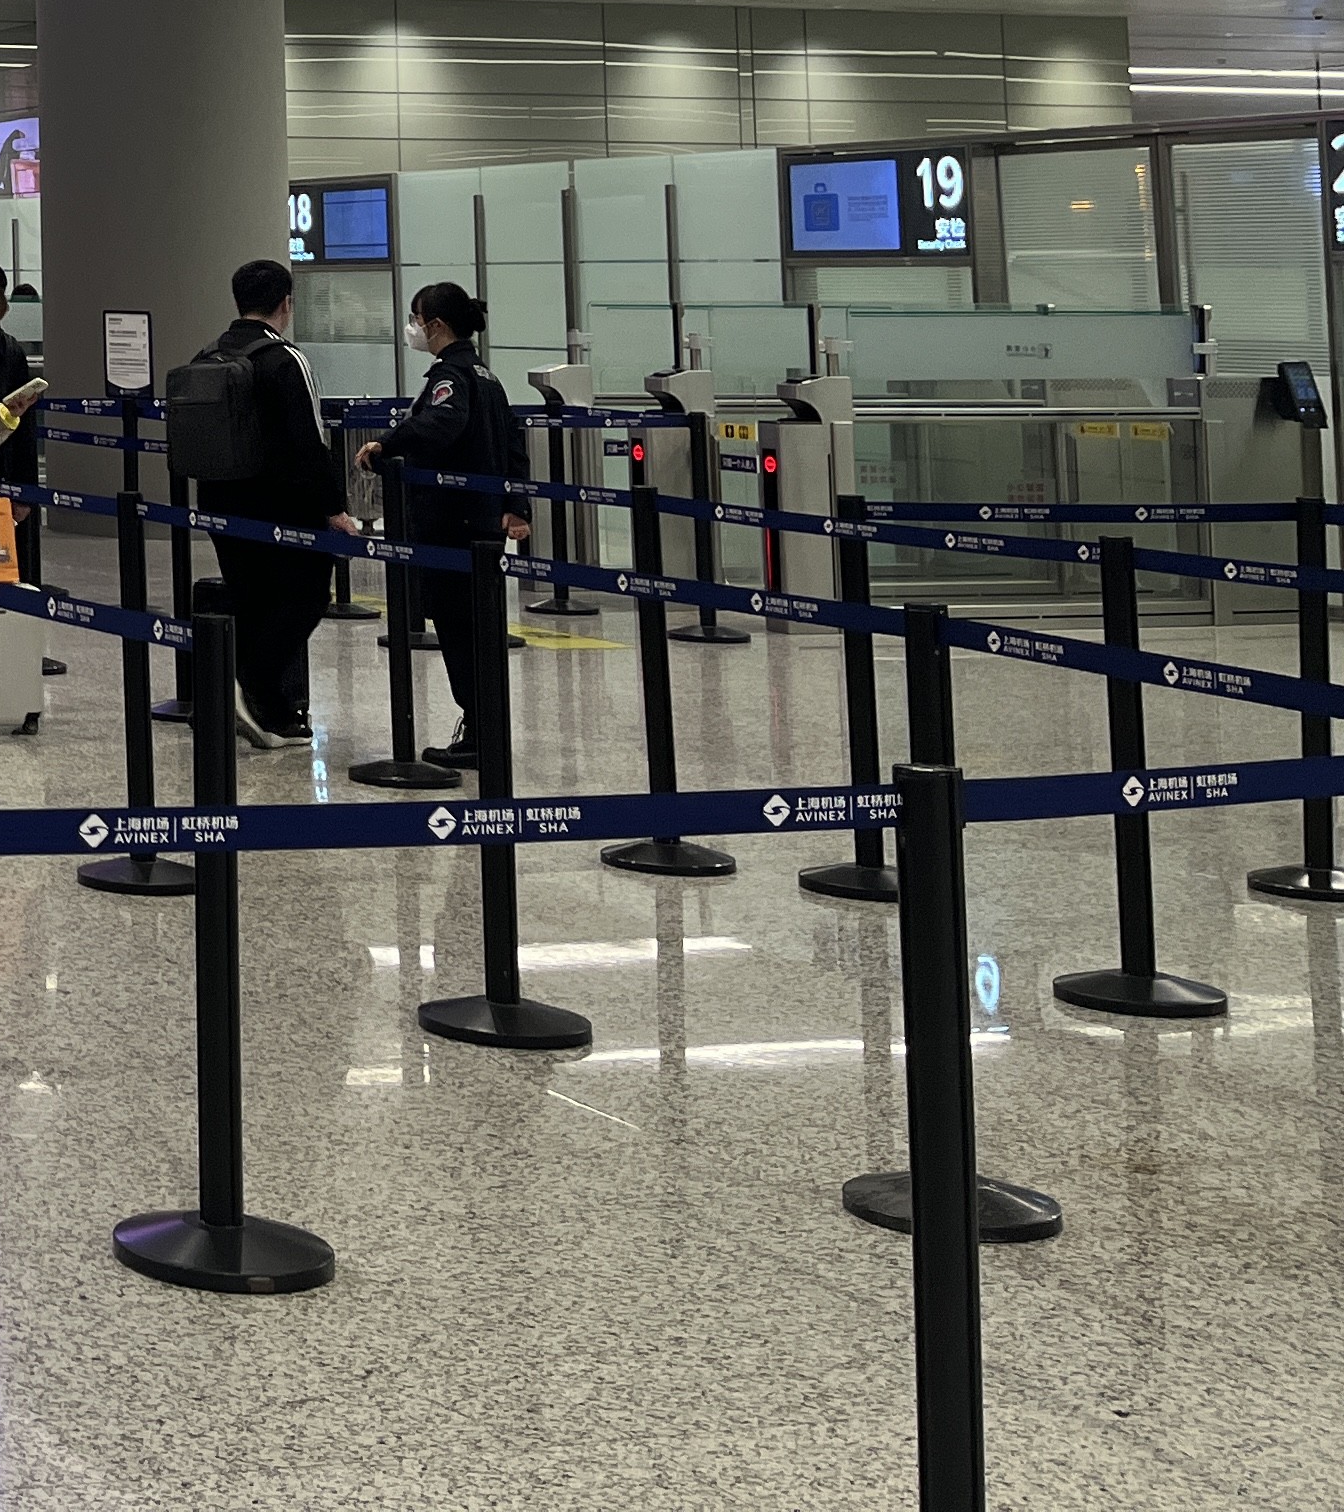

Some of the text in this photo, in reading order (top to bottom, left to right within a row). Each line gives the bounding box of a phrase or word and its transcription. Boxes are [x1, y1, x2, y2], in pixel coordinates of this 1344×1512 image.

[916, 155, 964, 209] 19
[288, 193, 313, 232] 18
[1181, 676, 1244, 695] AVINEX SHA
[1148, 772, 1238, 790] 上海机场 虹桥机场
[795, 796, 846, 810] 上海机场
[1148, 788, 1229, 802] AVINEX SHA
[113, 815, 239, 831] 上海机场 虹桥机场
[462, 806, 581, 824] 上海机场 虹桥机场
[795, 808, 898, 822] AVINEX SHA
[462, 822, 569, 836] AVINEX SHA
[114, 831, 226, 844] AVINEX SHA
